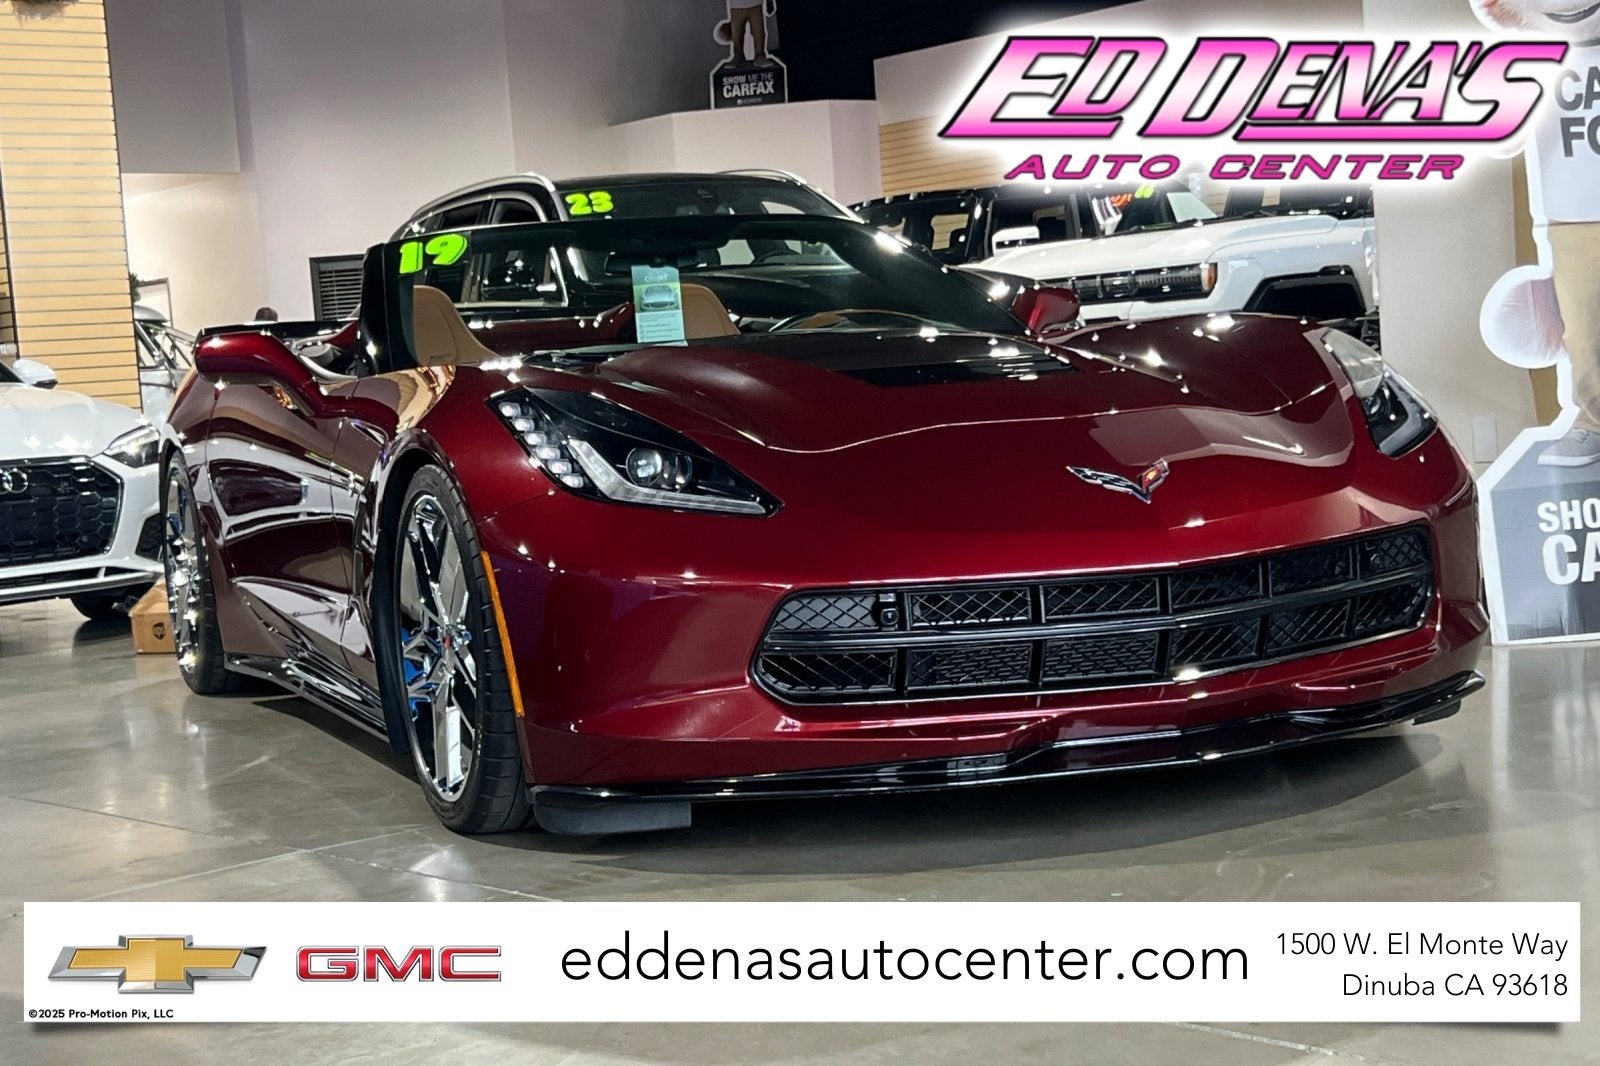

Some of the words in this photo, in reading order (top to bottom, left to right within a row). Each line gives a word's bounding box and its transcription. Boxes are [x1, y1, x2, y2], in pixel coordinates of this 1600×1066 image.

[723, 74, 746, 85] SHOW
[761, 72, 774, 81] THE
[723, 81, 774, 98] CARFAX
[565, 191, 614, 215] 23
[399, 233, 468, 274] 19
